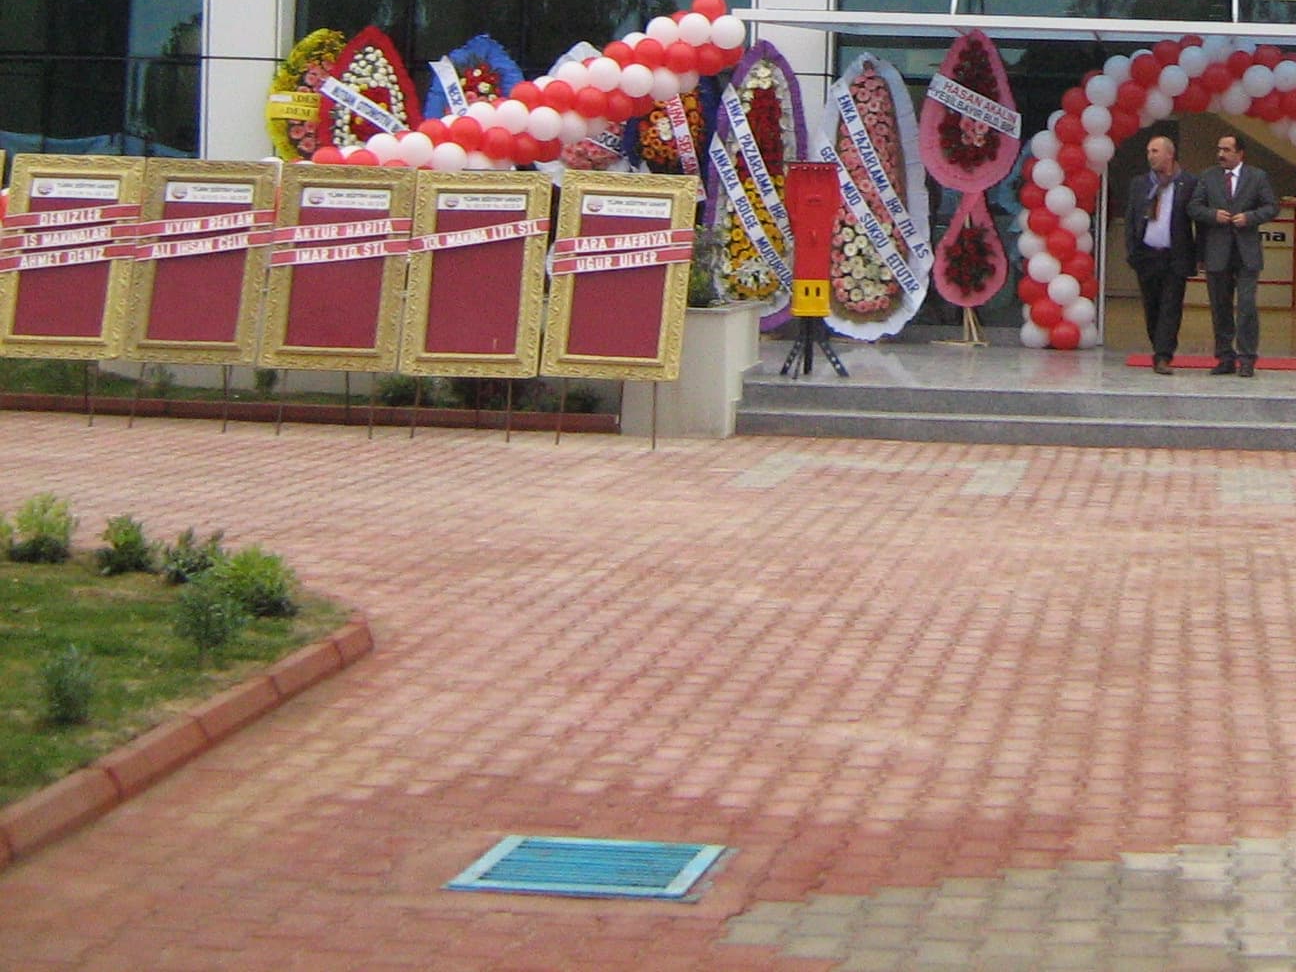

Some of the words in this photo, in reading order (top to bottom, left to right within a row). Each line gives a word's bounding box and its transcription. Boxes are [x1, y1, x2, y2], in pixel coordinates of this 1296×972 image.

[944, 81, 983, 106] HASAN
[726, 98, 745, 127] ENKA
[739, 133, 773, 196] PAZARLAMA
[837, 94, 858, 123] ENKA
[853, 129, 890, 192] PAZARLAMA
[711, 148, 740, 190] ANKARA
[294, 226, 339, 241] AKTUR
[346, 219, 393, 237] HARITA
[574, 236, 608, 252] LARA
[614, 230, 673, 248] HAFRIYAT
[20, 252, 61, 268] AHMET
[68, 247, 105, 263] DENIZ
